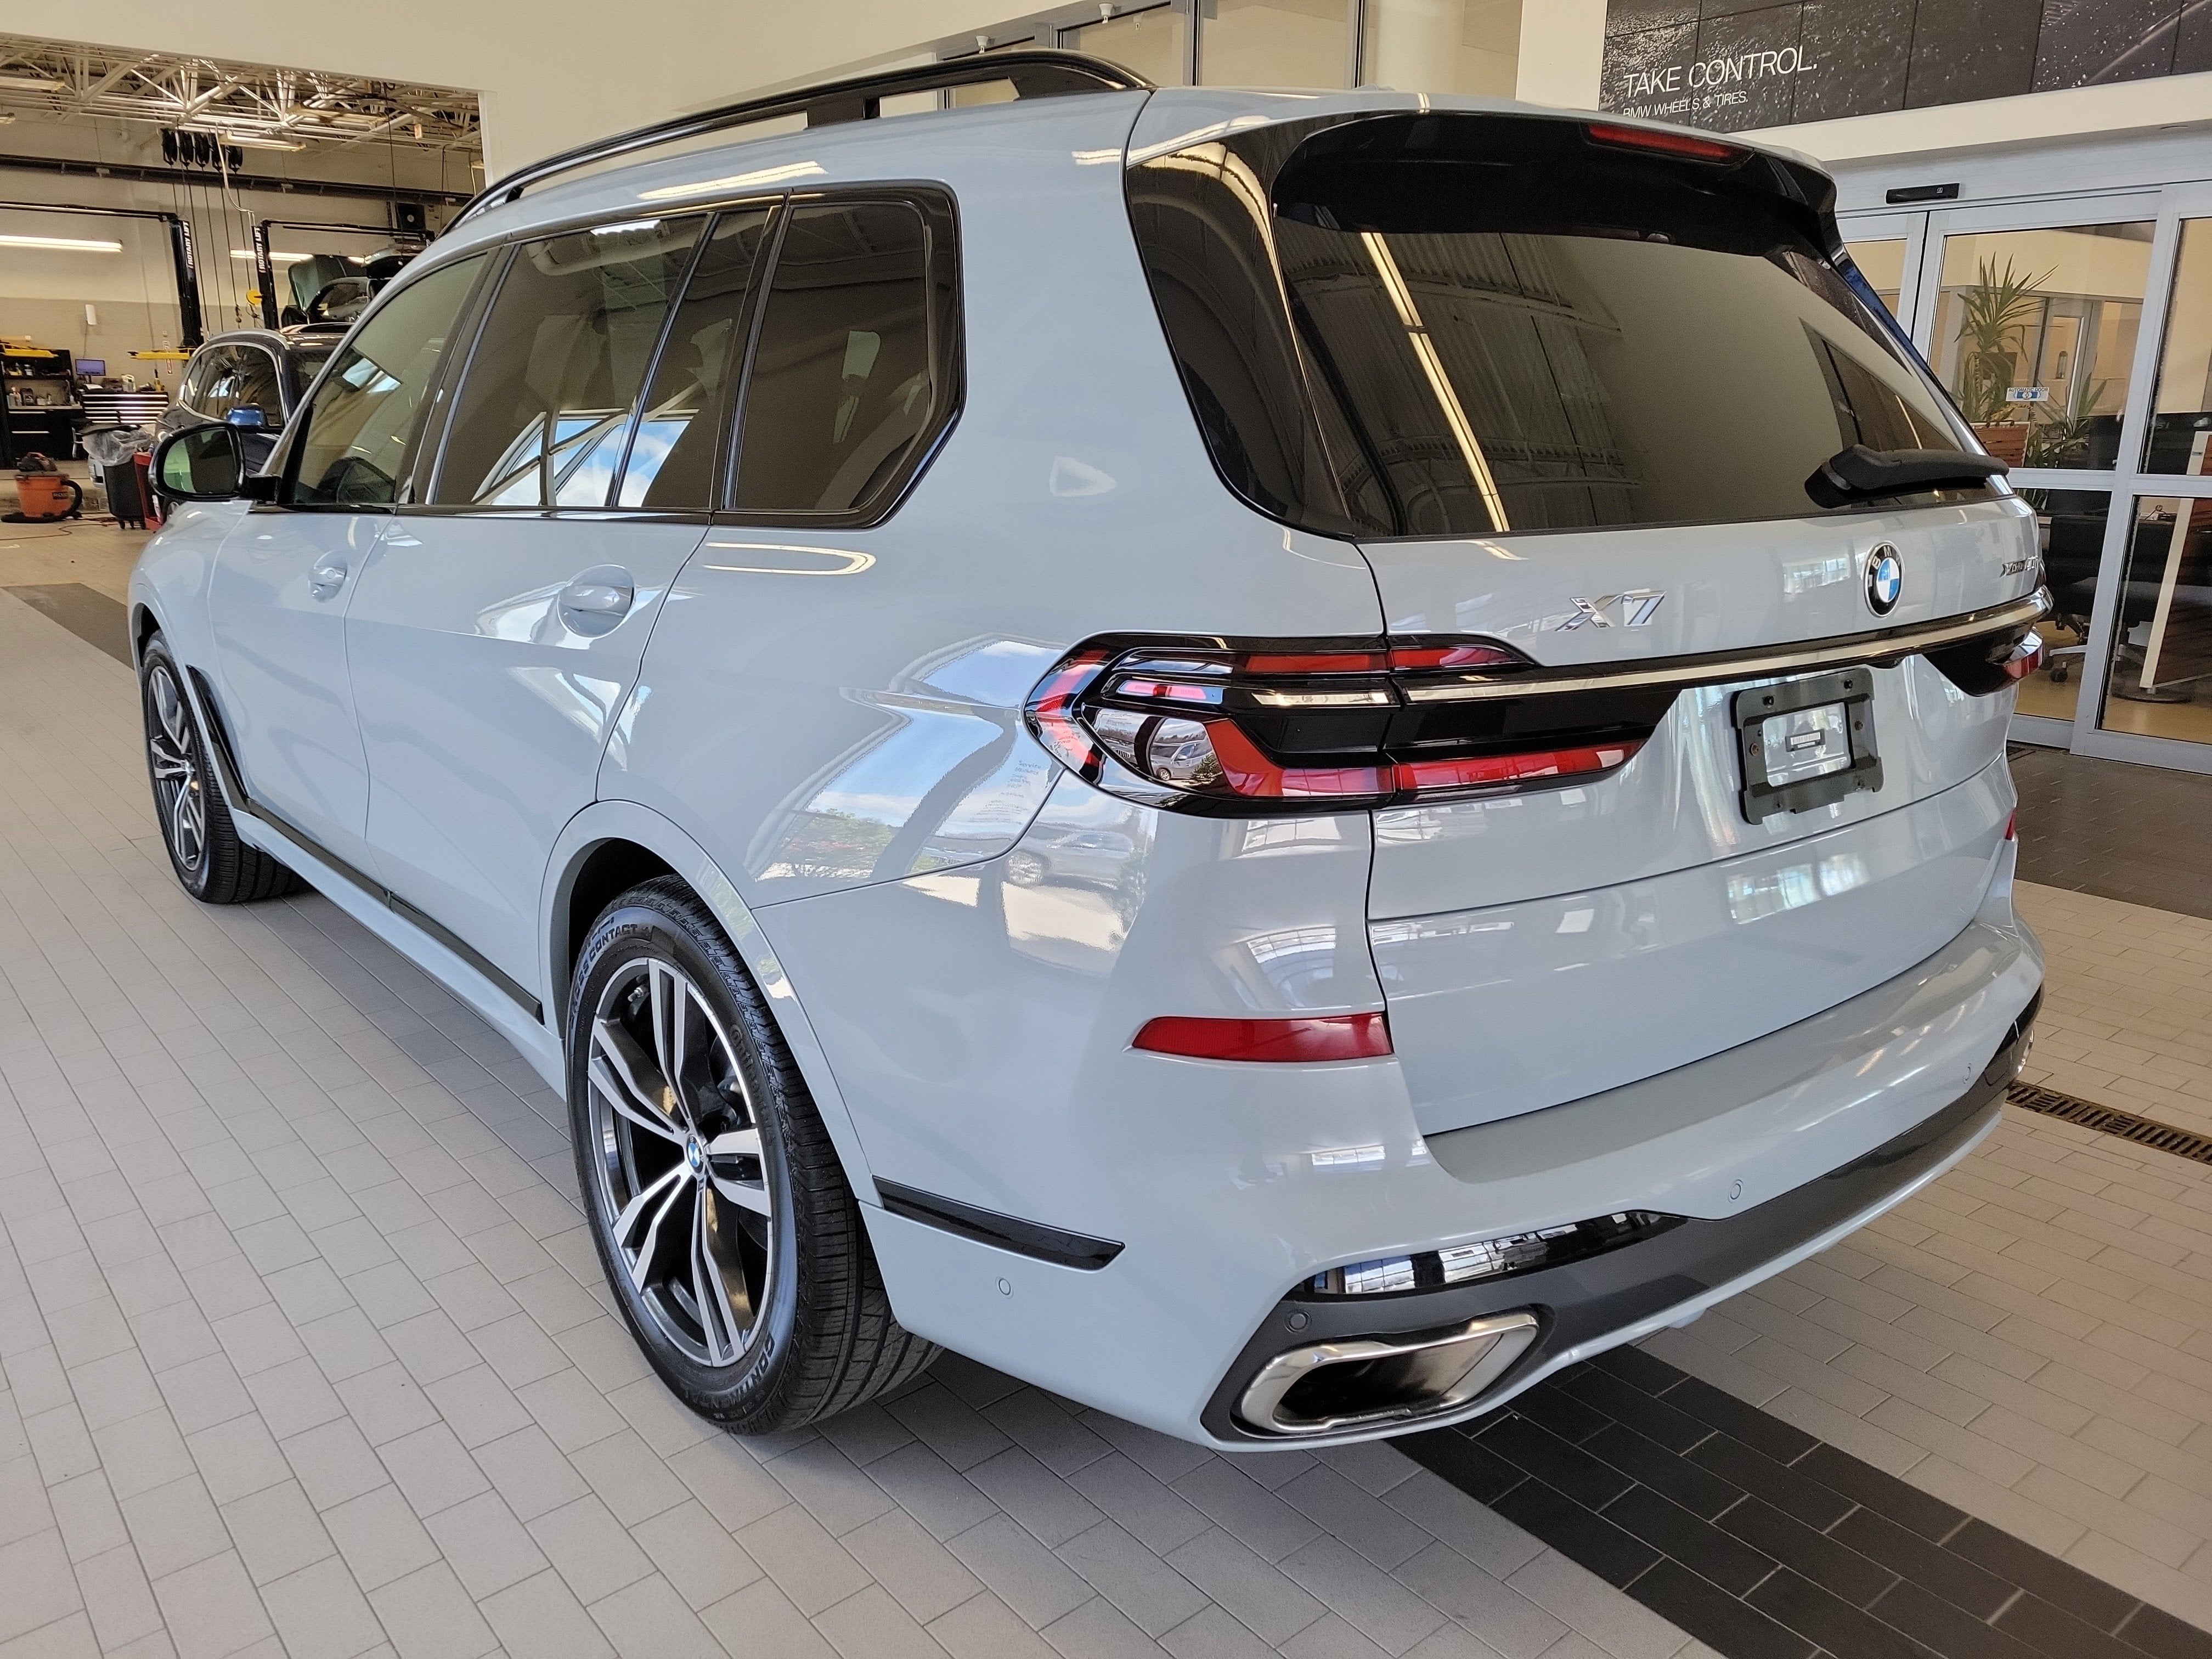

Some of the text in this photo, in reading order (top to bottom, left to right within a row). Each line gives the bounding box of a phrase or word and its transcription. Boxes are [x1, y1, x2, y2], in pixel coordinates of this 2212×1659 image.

[1623, 45, 1818, 98] TAKE CONTROL.
[1654, 97, 1701, 115] WHEELS
[1702, 94, 1711, 109] &
[1715, 91, 1749, 108] TIRES.
[184, 237, 194, 266] ROTARY
[256, 242, 266, 269] ROTARY
[1555, 590, 1666, 631] X7
[589, 923, 638, 962] CONTACT
